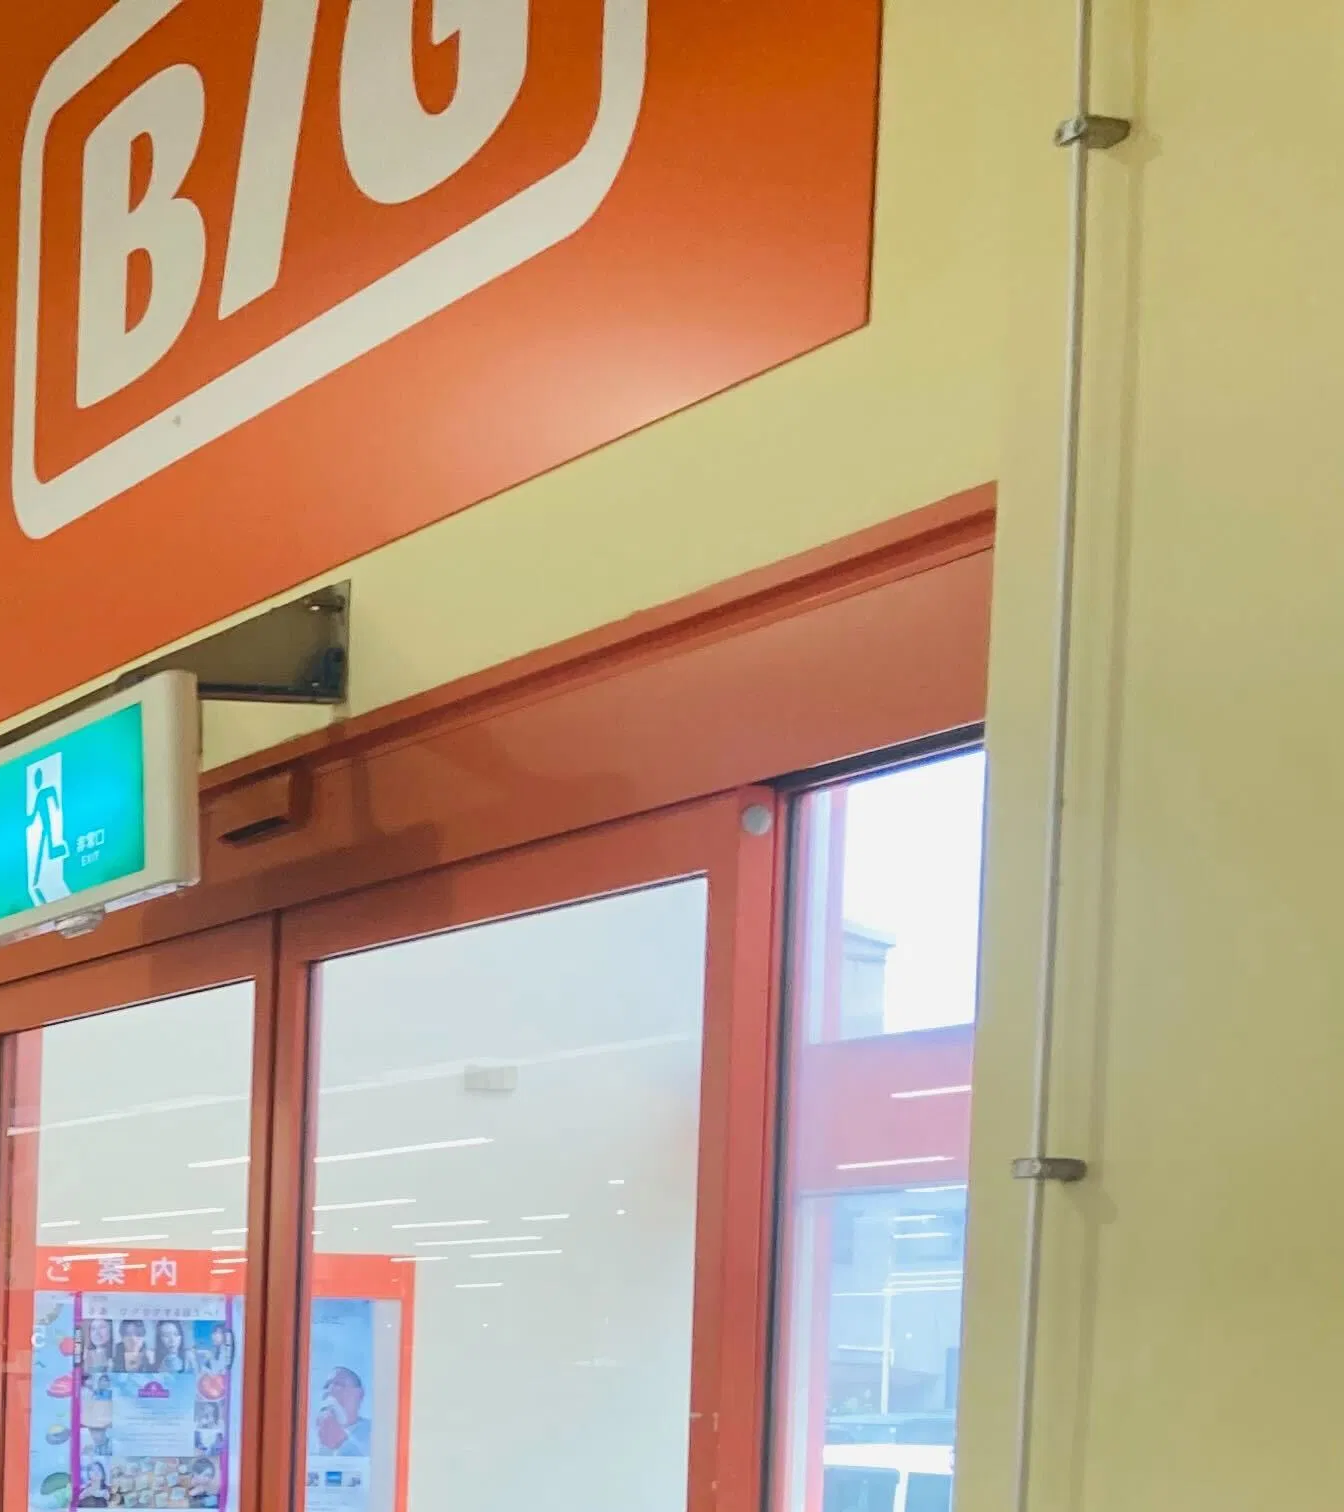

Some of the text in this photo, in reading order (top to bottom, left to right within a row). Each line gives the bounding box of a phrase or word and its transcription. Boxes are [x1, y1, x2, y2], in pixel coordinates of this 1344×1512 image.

[76, 0, 528, 408] BIG
[76, 829, 104, 852] 非常口
[45, 1255, 178, 1287] ご案内
